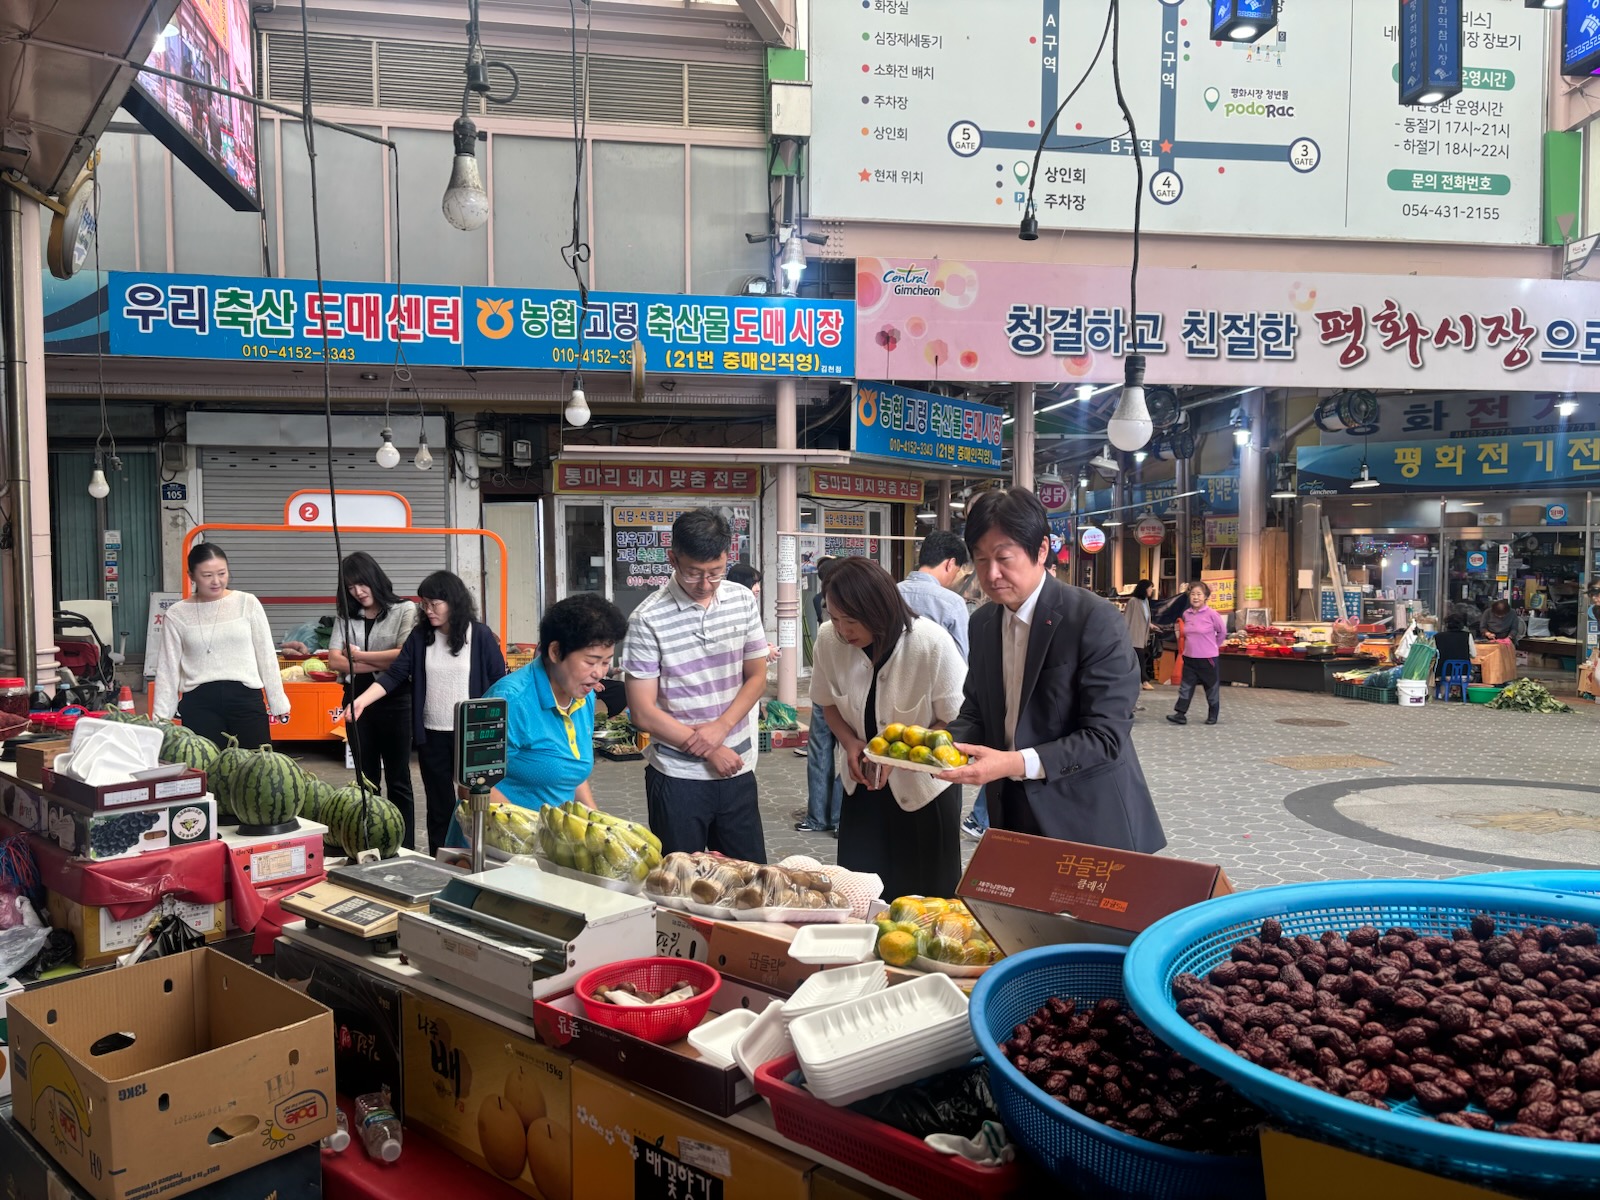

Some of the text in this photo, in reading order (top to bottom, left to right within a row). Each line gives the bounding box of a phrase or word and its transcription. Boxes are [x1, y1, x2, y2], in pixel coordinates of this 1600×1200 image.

[874, 0, 909, 15] 화장실
[874, 31, 943, 49] 심장제세동기
[1438, 0, 1448, 65] 화역참시장
[1043, 14, 1057, 73] A구역
[1482, 33, 1522, 50] 장보기
[1161, 31, 1176, 89] C구역
[873, 64, 935, 80] 소화전 배치
[873, 95, 909, 110] 주차장
[1230, 88, 1264, 100] 평화시장
[1455, 100, 1504, 117] 운영시간
[873, 127, 909, 141] 상인회
[961, 128, 971, 142] 5
[1404, 117, 1511, 138] 동절기 17시~21시
[954, 141, 977, 151] GATE
[1300, 145, 1309, 157] 3
[1403, 139, 1510, 159] 하절기 18시~22시
[1294, 158, 1314, 167] GATE
[874, 169, 924, 185] 현재 위치
[1044, 167, 1087, 185] 상인회
[1161, 176, 1172, 189] 4
[1411, 173, 1493, 191] 문의 전화번호
[1156, 189, 1177, 198] GATE
[1044, 194, 1087, 211] 주차장
[1402, 203, 1501, 220] 054-431-2155
[882, 264, 930, 285] Central
[894, 284, 941, 297] Gimcheon
[124, 284, 463, 344] 우리 축산 도매센터
[520, 298, 845, 348] 농협 고령 축산물 도매시장
[1004, 304, 1168, 358] 청결하고
[1181, 309, 1300, 362] 친절한
[551, 346, 648, 366] 010-4152-33
[664, 349, 715, 370] (21번
[721, 351, 821, 373] 중매인직영)
[879, 391, 1003, 446] 농협 고령 축산물 도매시장
[564, 467, 749, 490] 통마리 돼지 맞춤 전문
[854, 477, 875, 494] 돼지
[877, 479, 897, 495] 맞춤
[899, 483, 919, 497] 전문
[166, 490, 183, 500] 105
[304, 506, 314, 518] 2
[616, 531, 659, 547] 한우고기
[626, 575, 669, 587] 010-4152
[1076, 878, 1108, 894] 클래식
[417, 1013, 439, 1039] 나주
[429, 1038, 461, 1099] 배
[545, 1061, 564, 1080] 15kg
[118, 1082, 148, 1102] 13KG
[285, 1104, 318, 1125] Dole
